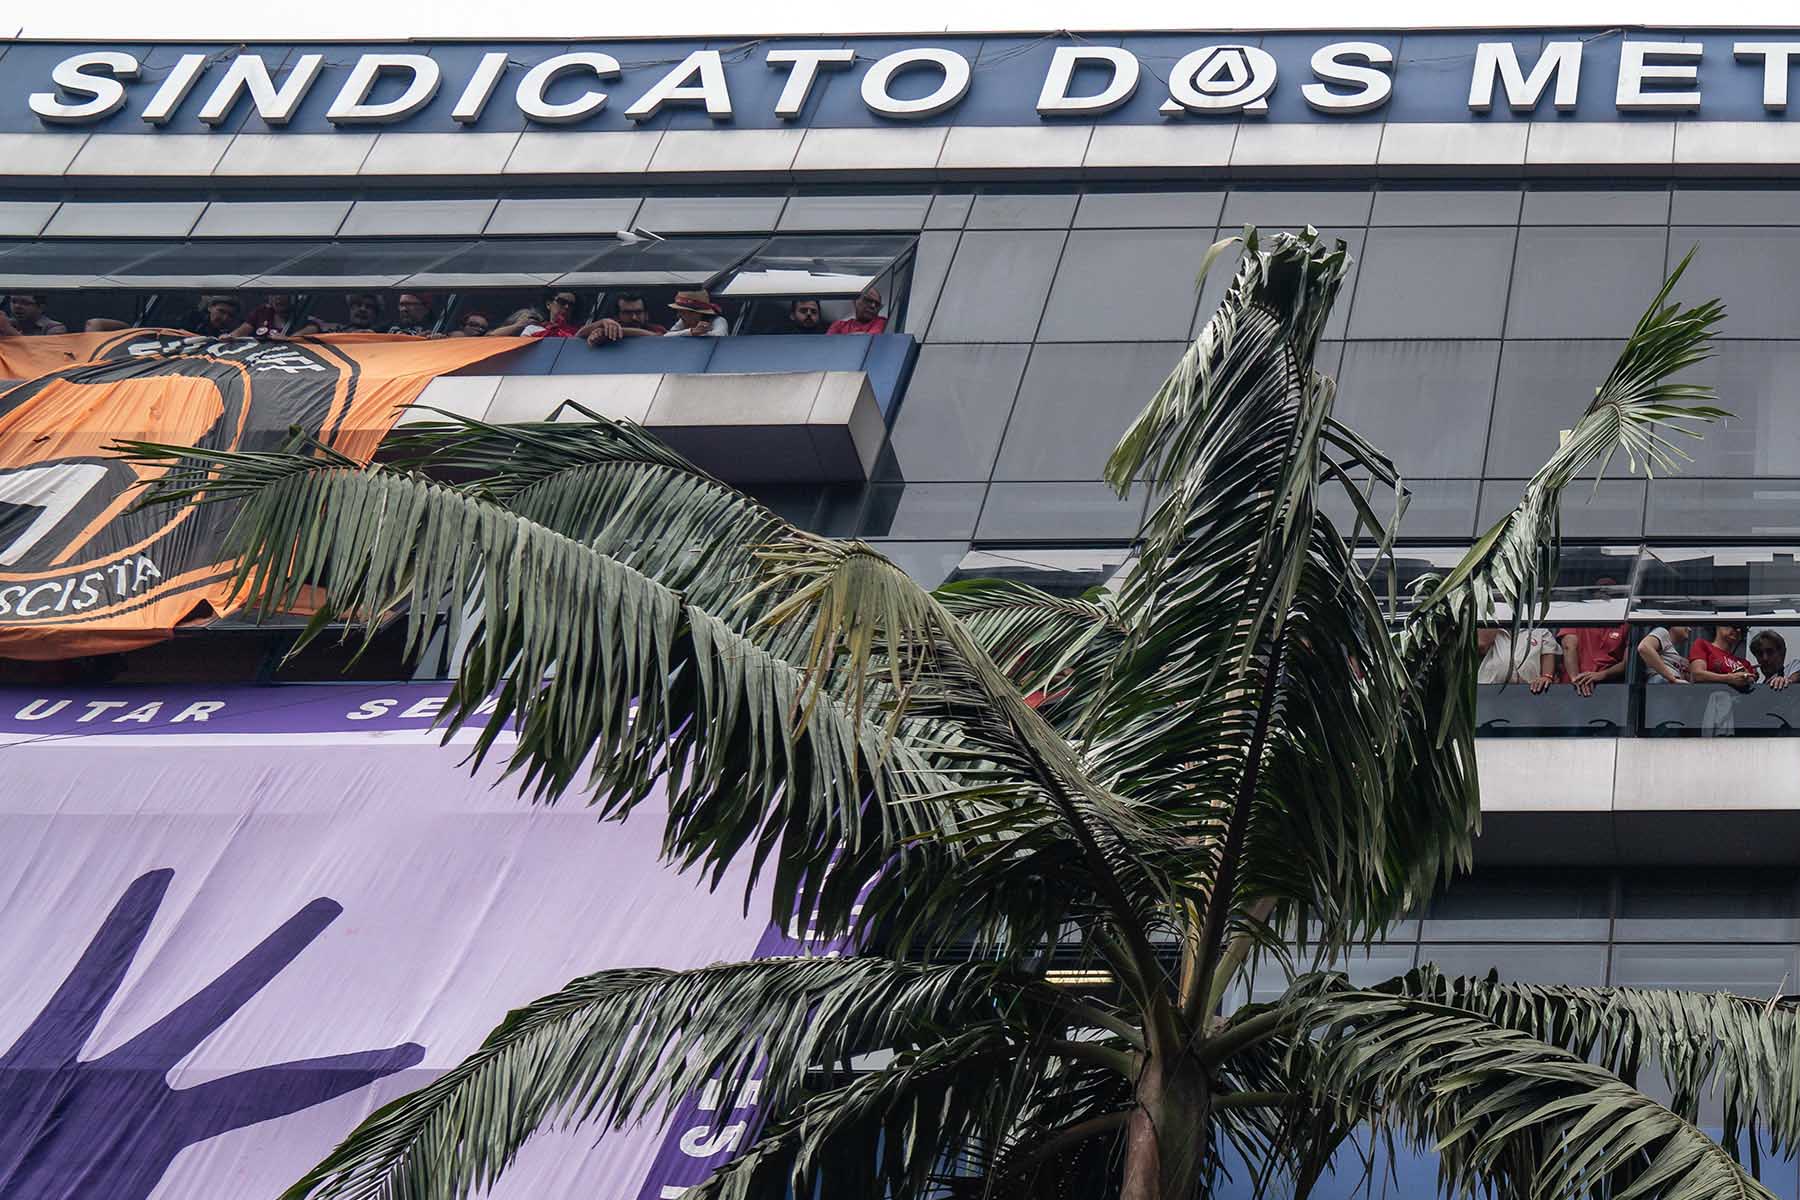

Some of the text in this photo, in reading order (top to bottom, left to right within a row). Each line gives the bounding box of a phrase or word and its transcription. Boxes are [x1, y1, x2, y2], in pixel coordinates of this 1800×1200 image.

[28, 47, 973, 126] SINDICATO
[1037, 41, 1394, 119] DOS
[15, 698, 226, 723] UTAR
